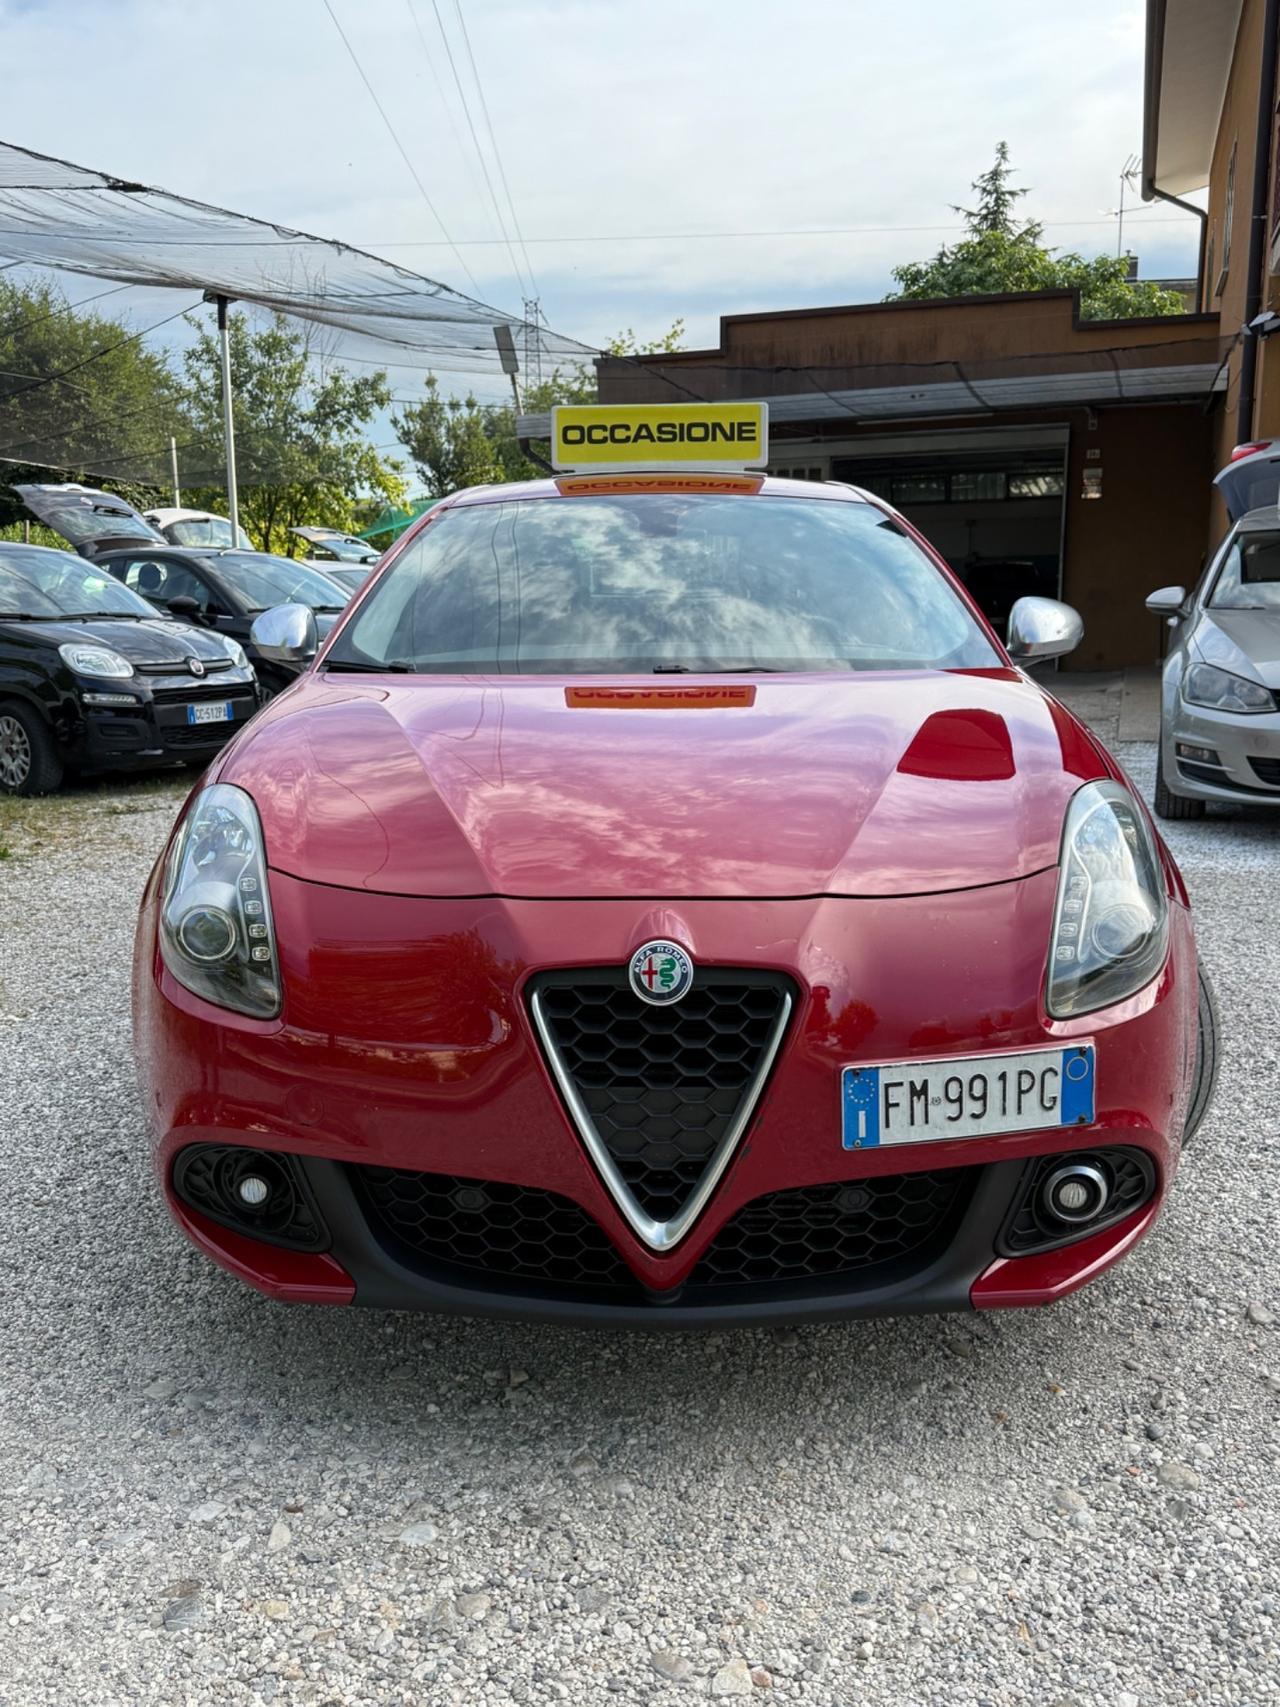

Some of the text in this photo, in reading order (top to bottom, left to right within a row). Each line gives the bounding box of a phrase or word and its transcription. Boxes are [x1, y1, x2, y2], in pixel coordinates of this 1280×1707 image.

[561, 422, 757, 445] OCCASIONE
[634, 946, 689, 974] ALFA ROMEO
[884, 1079, 930, 1129] FM
[944, 1067, 1059, 1122] 991PG
